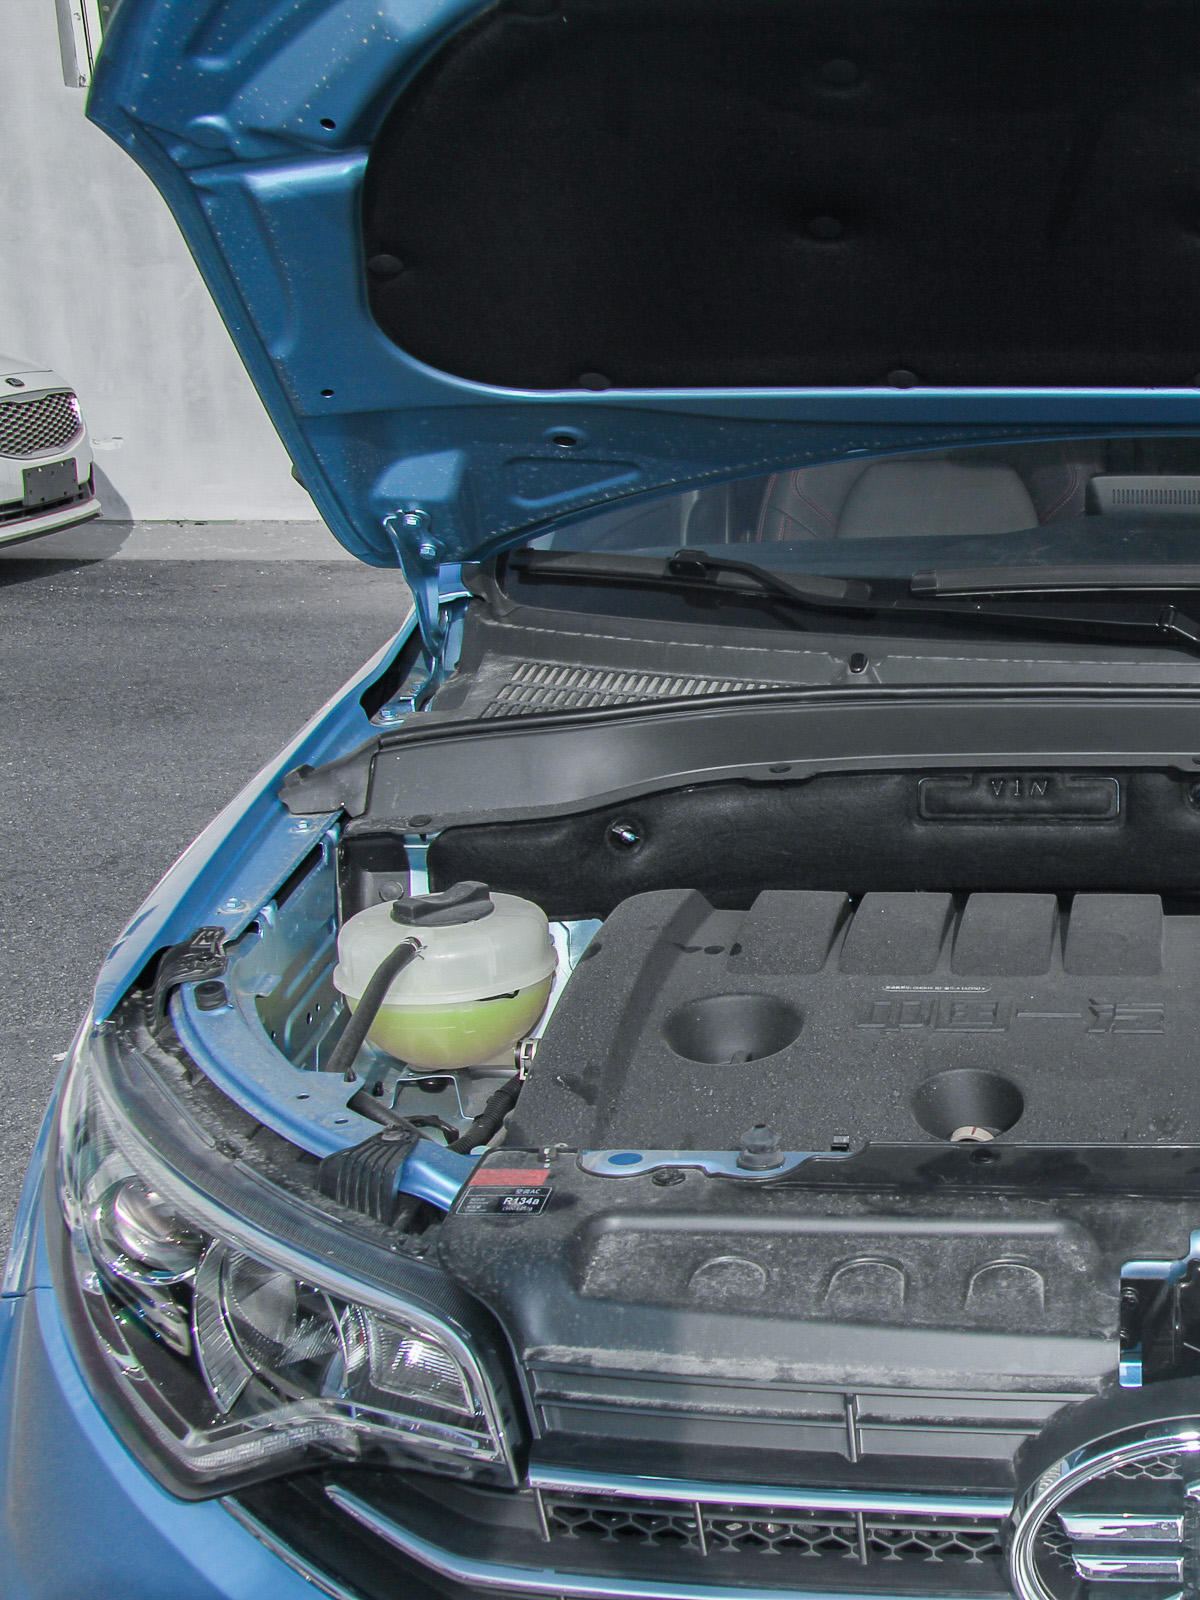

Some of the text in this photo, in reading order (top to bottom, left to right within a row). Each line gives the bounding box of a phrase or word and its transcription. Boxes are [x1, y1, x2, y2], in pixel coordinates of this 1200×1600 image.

[991, 780, 1048, 796] VIN
[856, 998, 1165, 1034] 中国一汽
[503, 1196, 540, 1205] R134a
